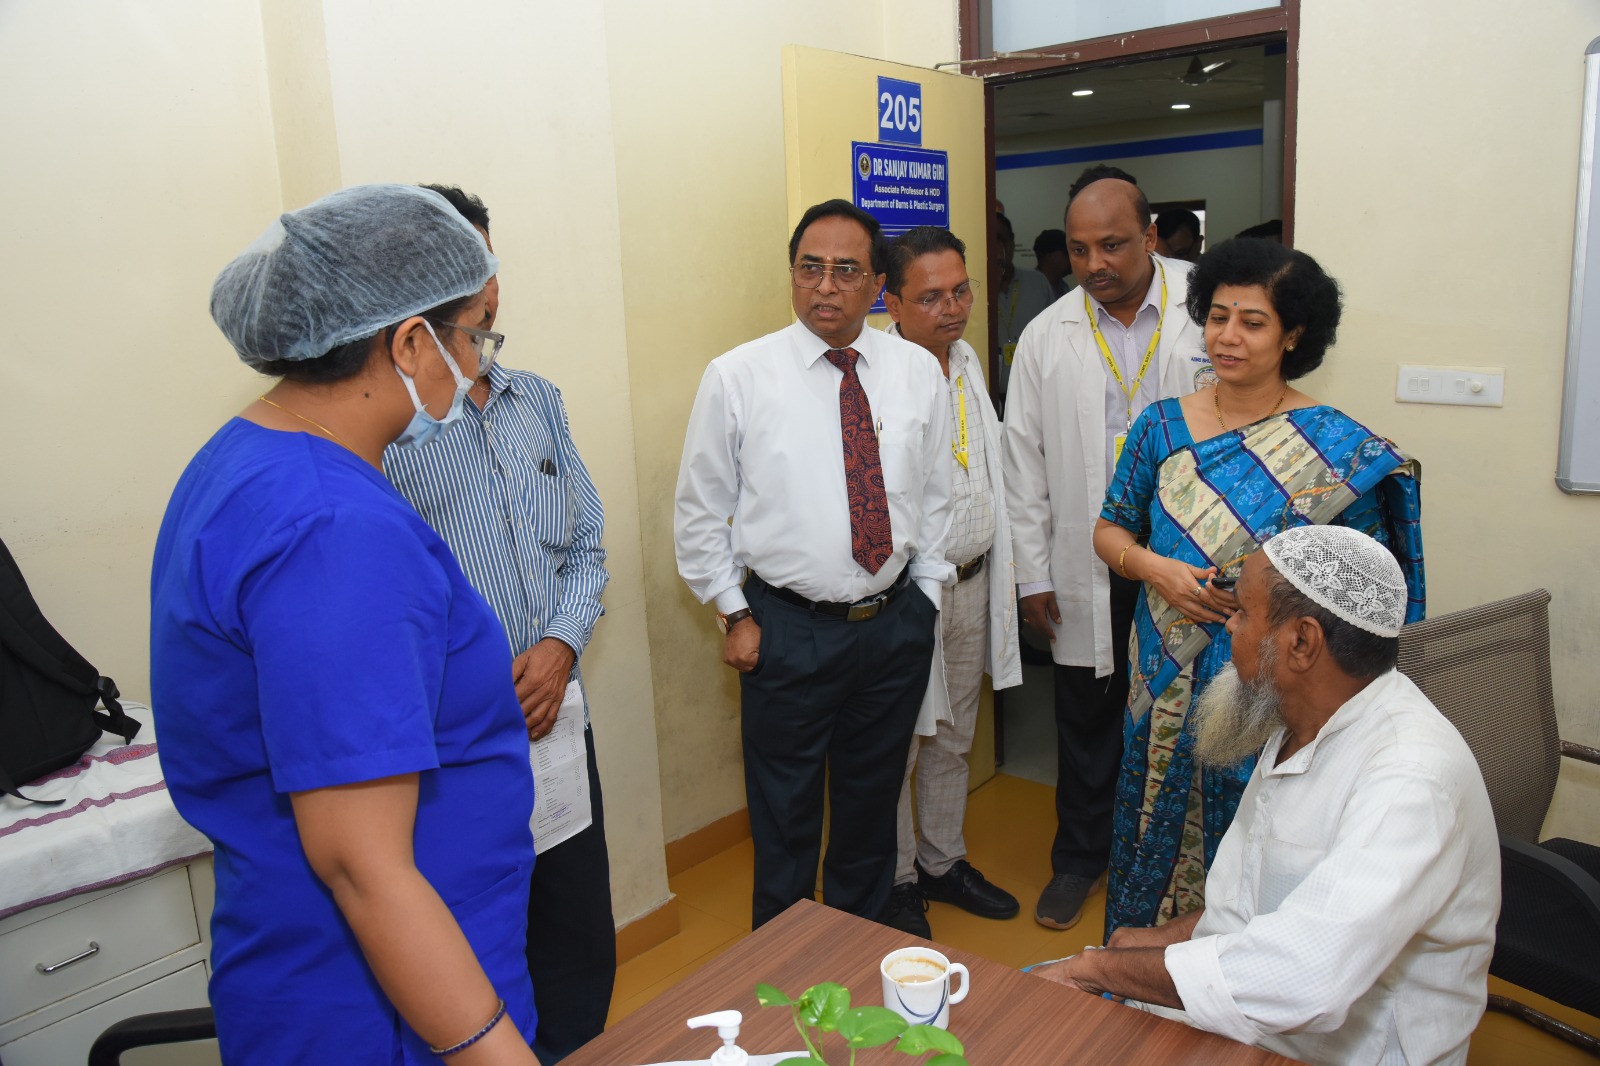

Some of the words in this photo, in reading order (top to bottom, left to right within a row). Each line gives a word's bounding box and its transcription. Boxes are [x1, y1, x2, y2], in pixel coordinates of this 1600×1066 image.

[880, 92, 921, 133] 205
[873, 158, 883, 176] DR
[884, 160, 907, 180] SANJAY
[909, 162, 931, 180] KUMAR
[932, 164, 944, 180] GIRI
[875, 184, 899, 194] Associate
[901, 186, 923, 195] Professor
[930, 188, 940, 196] HOD
[861, 198, 889, 209] Department
[890, 199, 895, 208] of
[896, 200, 908, 209] Burns
[910, 200, 912, 209] &
[914, 201, 928, 210] Plastic
[929, 202, 944, 212] Surgery
